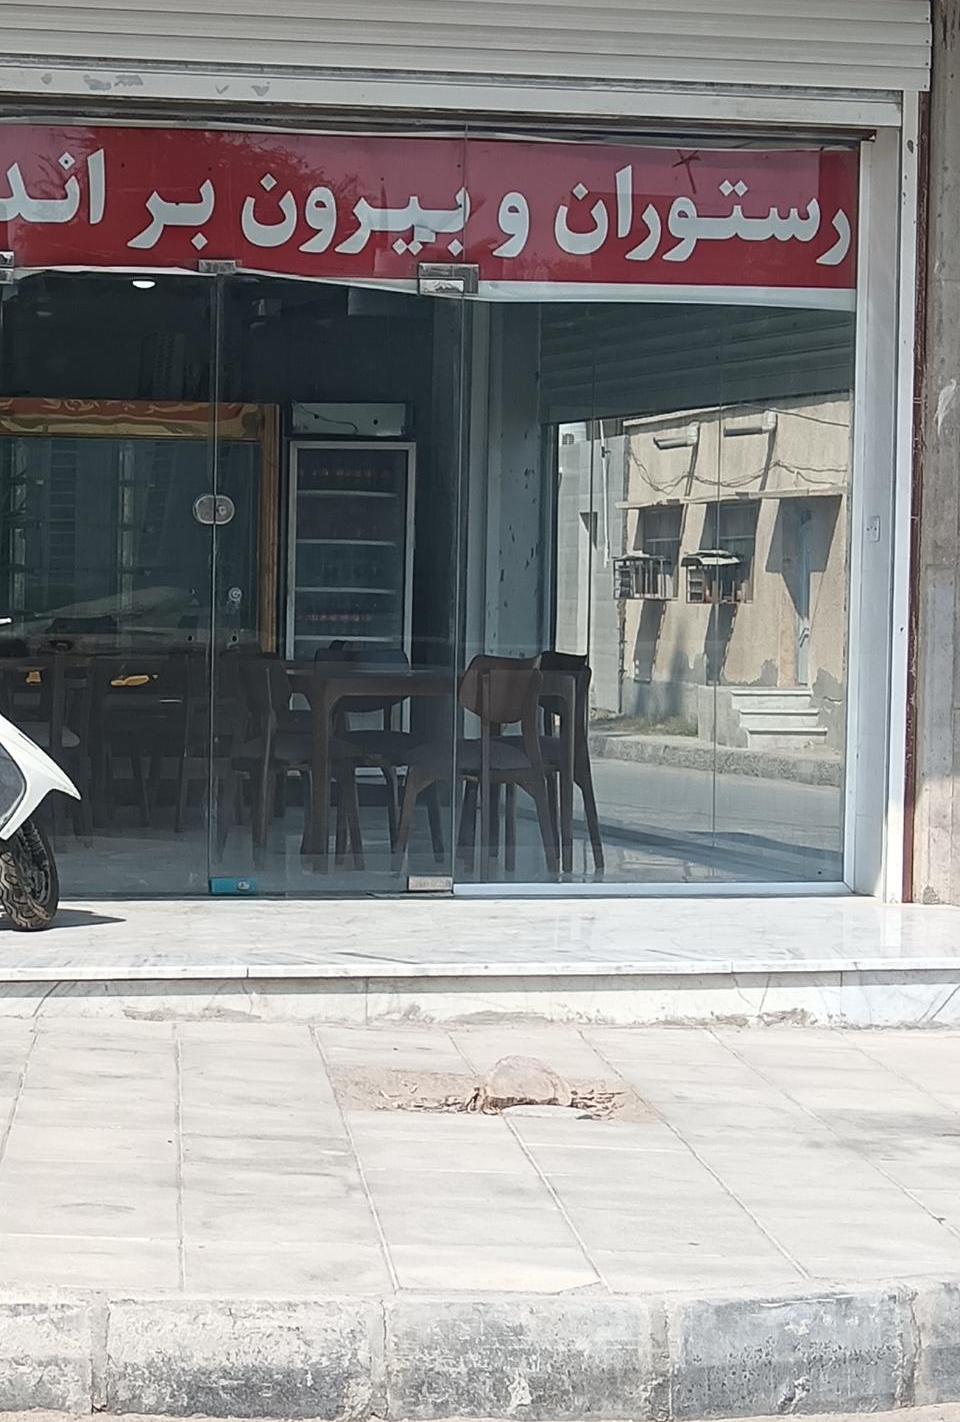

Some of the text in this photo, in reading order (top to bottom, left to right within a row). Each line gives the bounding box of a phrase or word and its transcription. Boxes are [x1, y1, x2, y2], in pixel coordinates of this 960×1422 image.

[126, 178, 216, 251] بر
[240, 172, 471, 258] بیرون
[491, 190, 531, 259] و
[553, 164, 852, 266] رستوران
